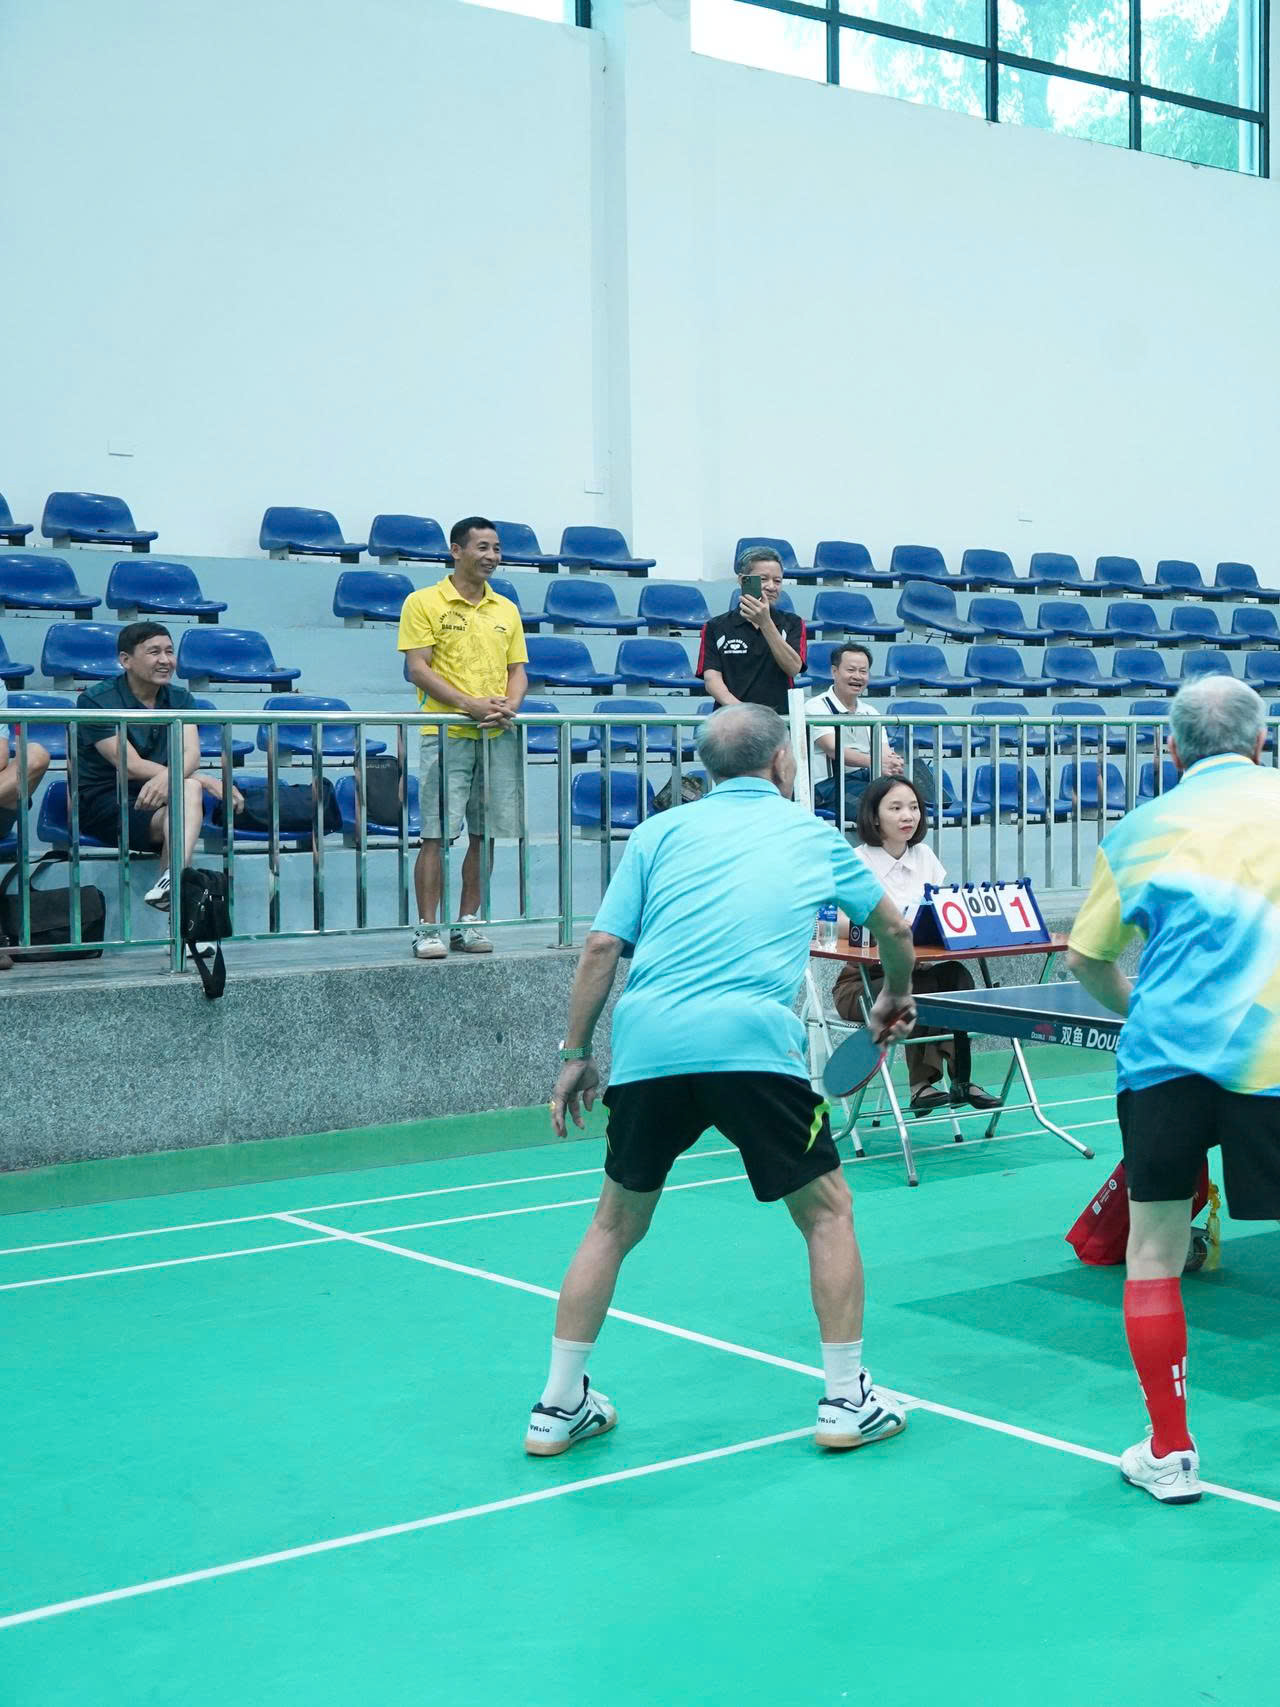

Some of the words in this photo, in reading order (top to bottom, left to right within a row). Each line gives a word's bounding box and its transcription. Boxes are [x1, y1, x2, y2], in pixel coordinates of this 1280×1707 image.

[942, 901, 967, 933] 0
[1010, 896, 1030, 928] 1
[1060, 1026, 1083, 1047] 双鱼
